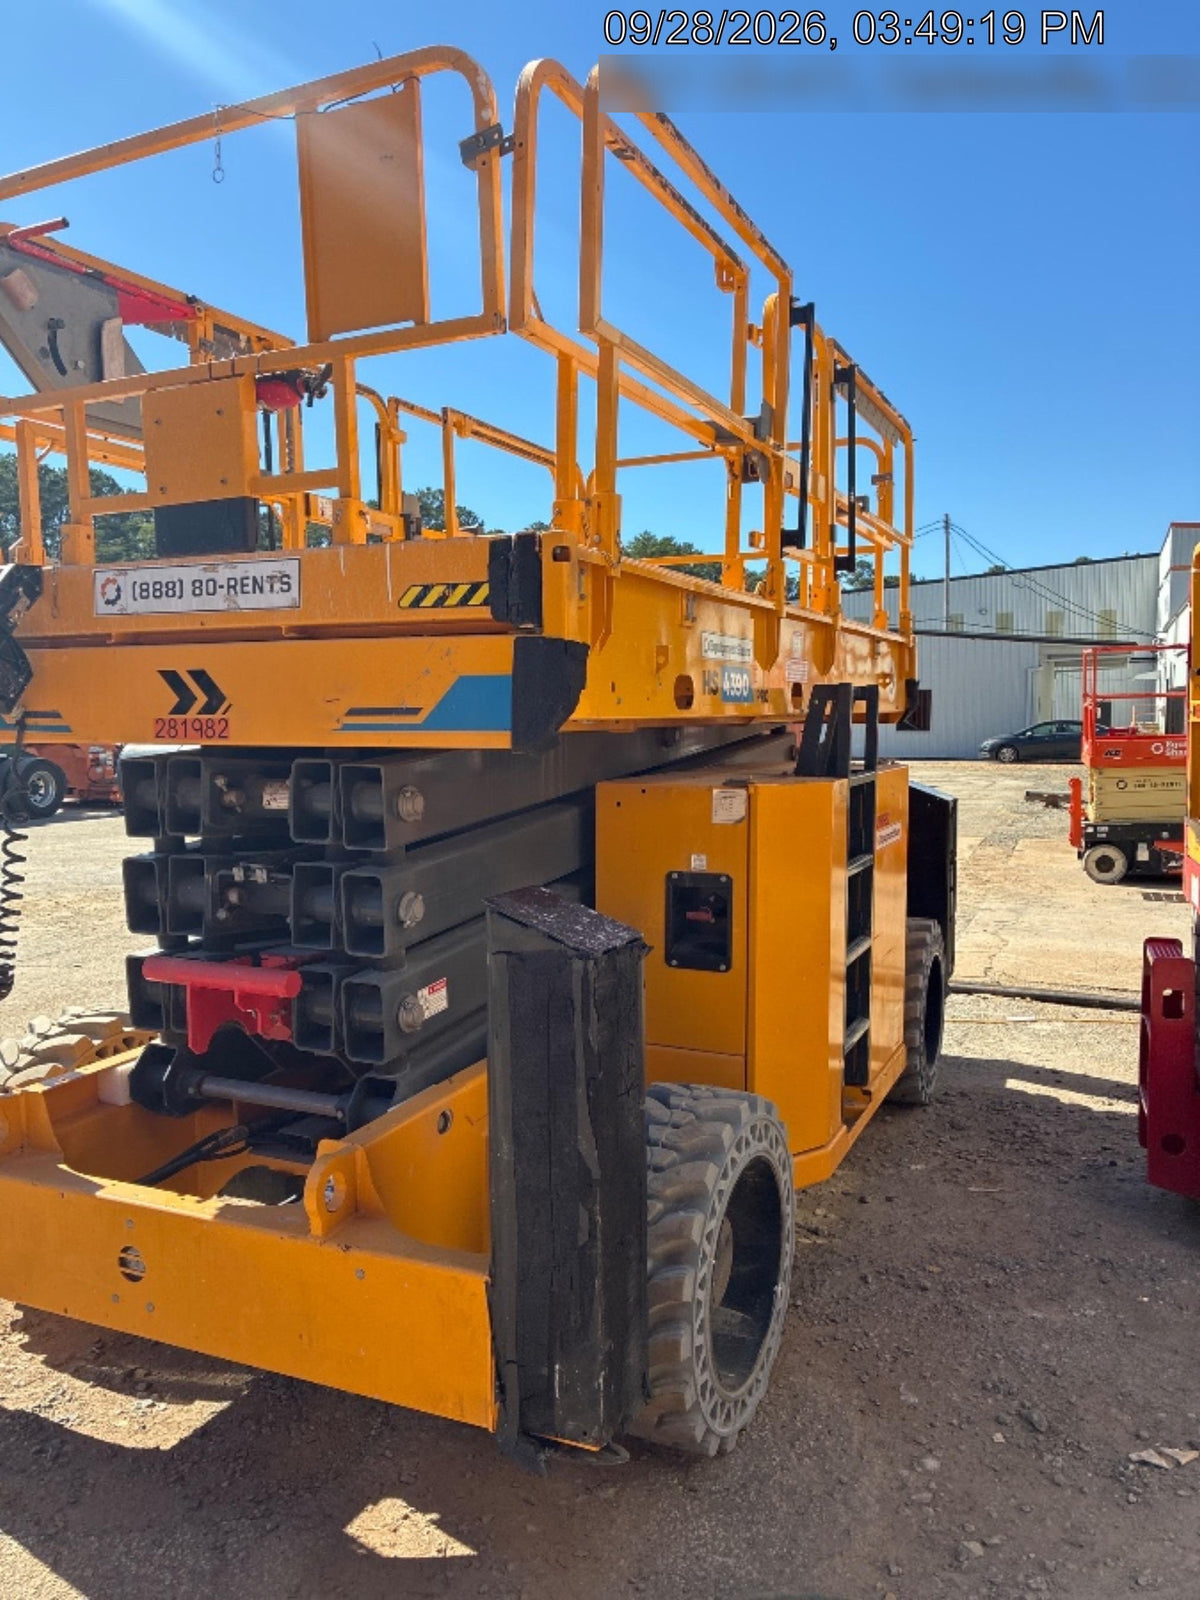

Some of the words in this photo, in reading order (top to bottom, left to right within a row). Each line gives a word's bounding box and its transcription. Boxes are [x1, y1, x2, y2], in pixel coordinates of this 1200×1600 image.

[132, 577, 184, 601] (888)
[191, 574, 292, 597] 80-RENTS
[723, 671, 750, 698] 4390
[155, 718, 228, 739] 281982
